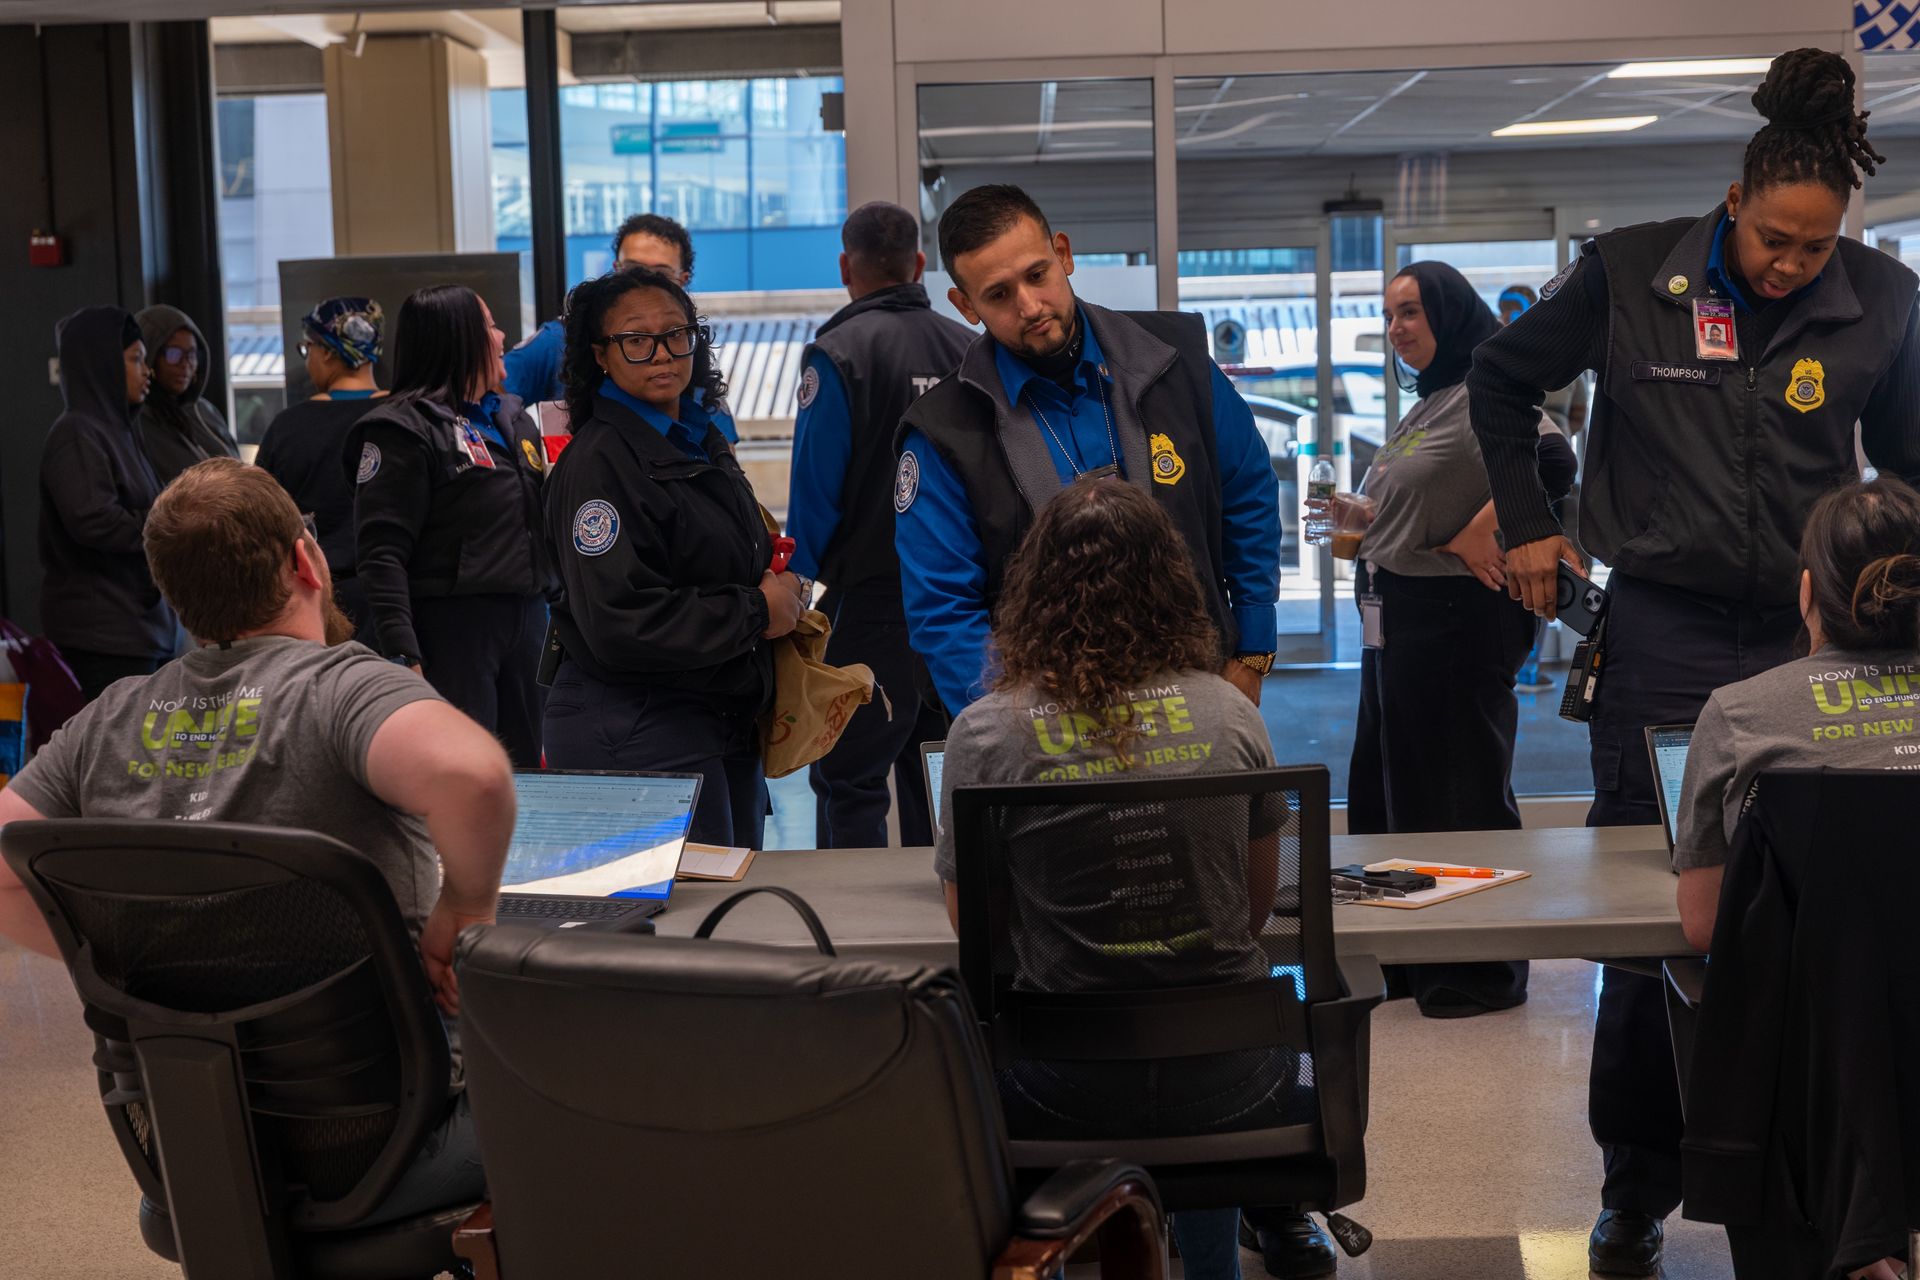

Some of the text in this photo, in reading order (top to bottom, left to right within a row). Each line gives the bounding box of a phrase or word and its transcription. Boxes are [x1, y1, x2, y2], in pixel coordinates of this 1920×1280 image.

[1651, 366, 1707, 380] THOMPSON
[912, 376, 941, 397] TS
[1808, 668, 1857, 683] NOW
[1863, 665, 1879, 677] IS
[192, 697, 208, 710] IS
[209, 691, 233, 708] THE
[236, 685, 265, 699] ME
[1105, 690, 1139, 704] TE
[1145, 684, 1182, 699] TIME
[1875, 696, 1893, 704] END
[1894, 693, 1920, 702] HUNG
[142, 698, 263, 750] UNIE
[1812, 718, 1914, 742] FOR NEW
[175, 733, 187, 741] TO
[189, 733, 207, 741] END
[165, 760, 212, 778] NEW
[1039, 741, 1213, 781] FOR NEW JERSEY
[189, 791, 209, 803] KID
[1740, 776, 1760, 818] ERVI
[1113, 827, 1169, 846] SENIORS
